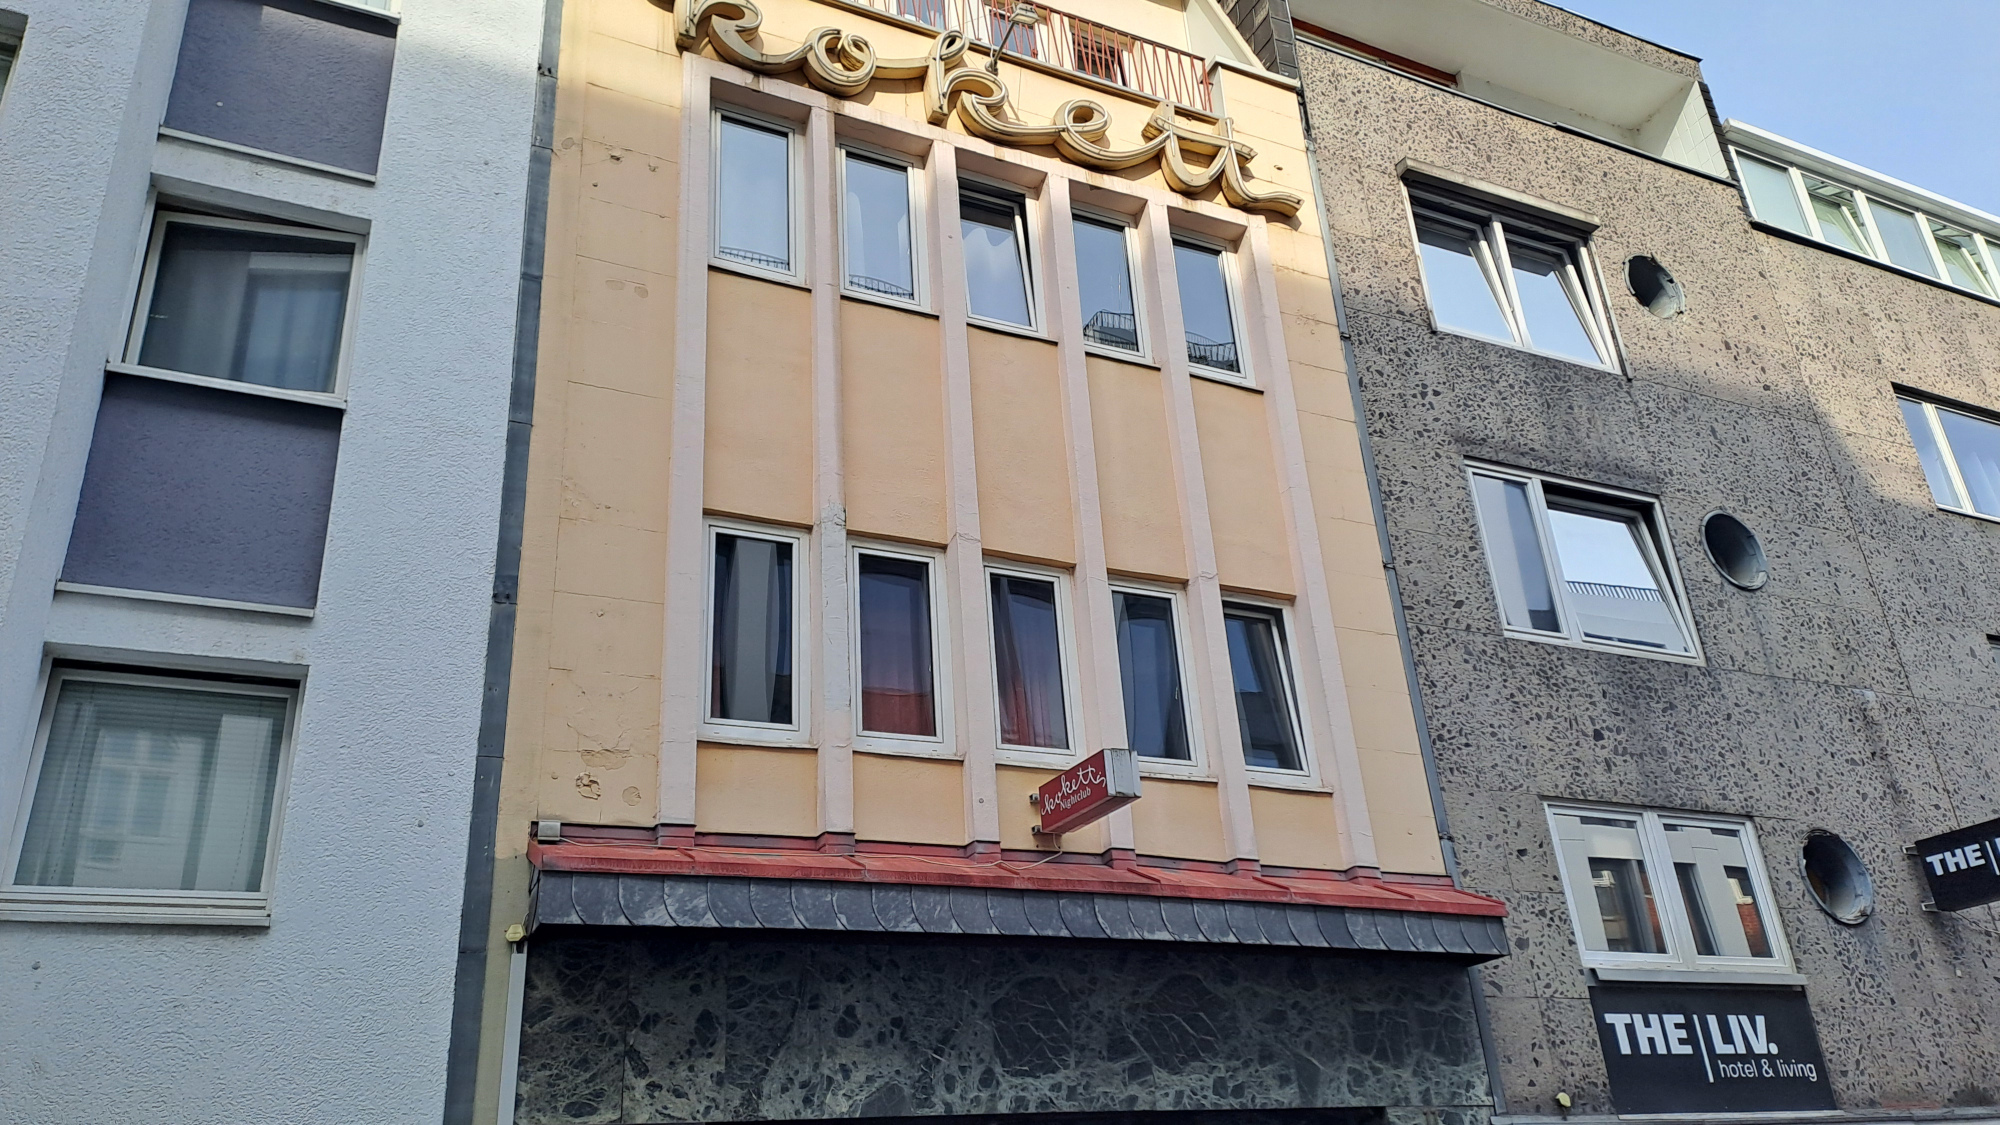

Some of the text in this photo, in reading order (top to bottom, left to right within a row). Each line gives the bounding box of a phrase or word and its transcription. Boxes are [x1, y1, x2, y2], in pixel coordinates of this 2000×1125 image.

[1059, 786, 1092, 811] Nightclub
[1925, 843, 1986, 876] THE
[1603, 1013, 1779, 1055] THE LIV.
[1717, 1058, 1818, 1082] hotel & living
